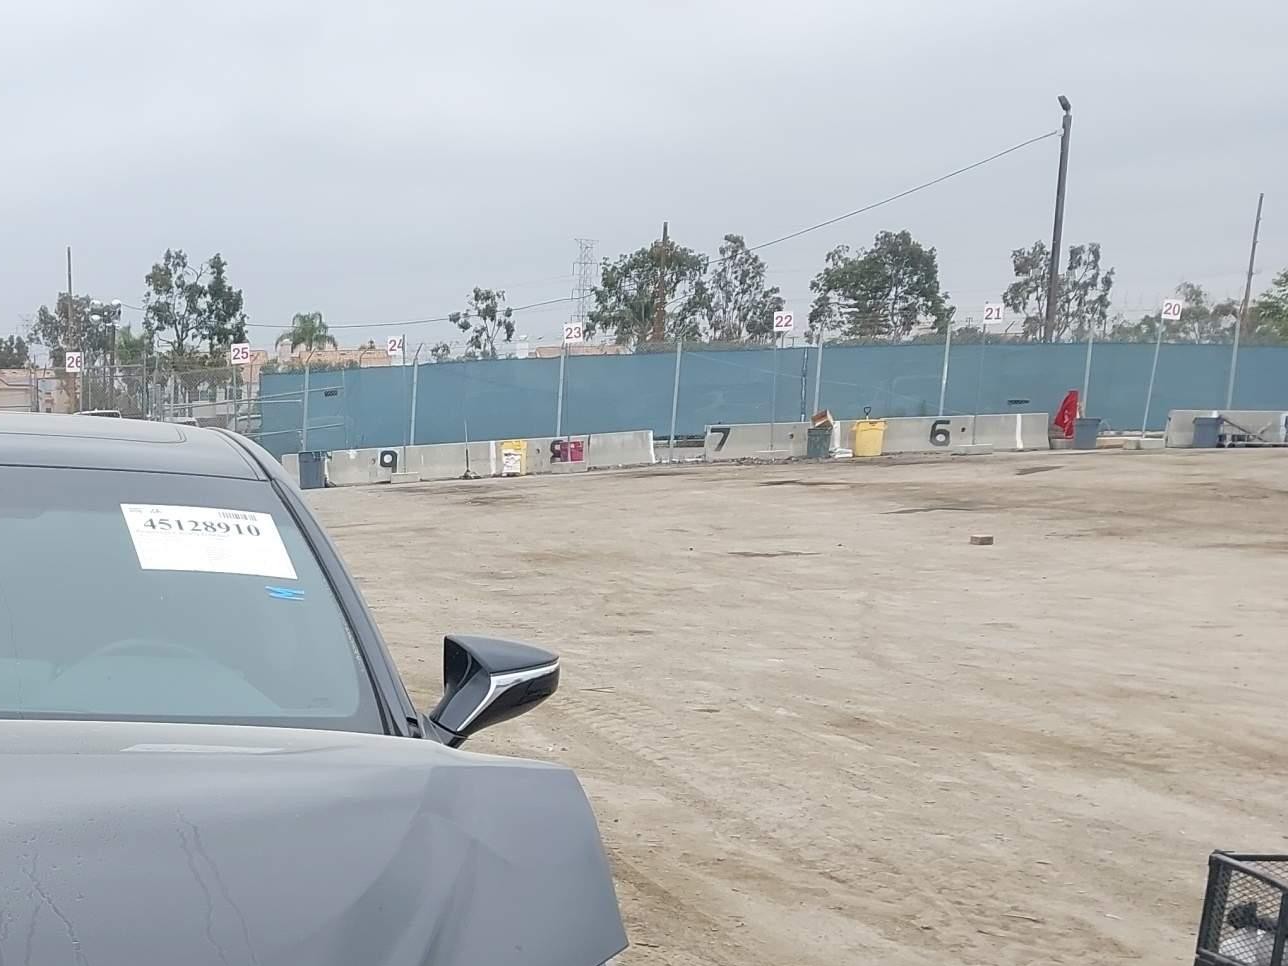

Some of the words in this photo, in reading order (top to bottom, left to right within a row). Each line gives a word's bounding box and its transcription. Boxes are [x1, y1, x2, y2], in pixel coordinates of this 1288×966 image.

[984, 307, 1001, 320] 21
[1163, 303, 1181, 316] 20
[775, 315, 793, 328] 22
[565, 327, 582, 339] 23
[388, 339, 403, 352] 24
[232, 347, 249, 360] 25
[67, 356, 81, 369] 26
[710, 428, 731, 452] 7
[929, 420, 951, 447] 6
[380, 450, 398, 473] 9
[143, 517, 261, 537] 45128910
